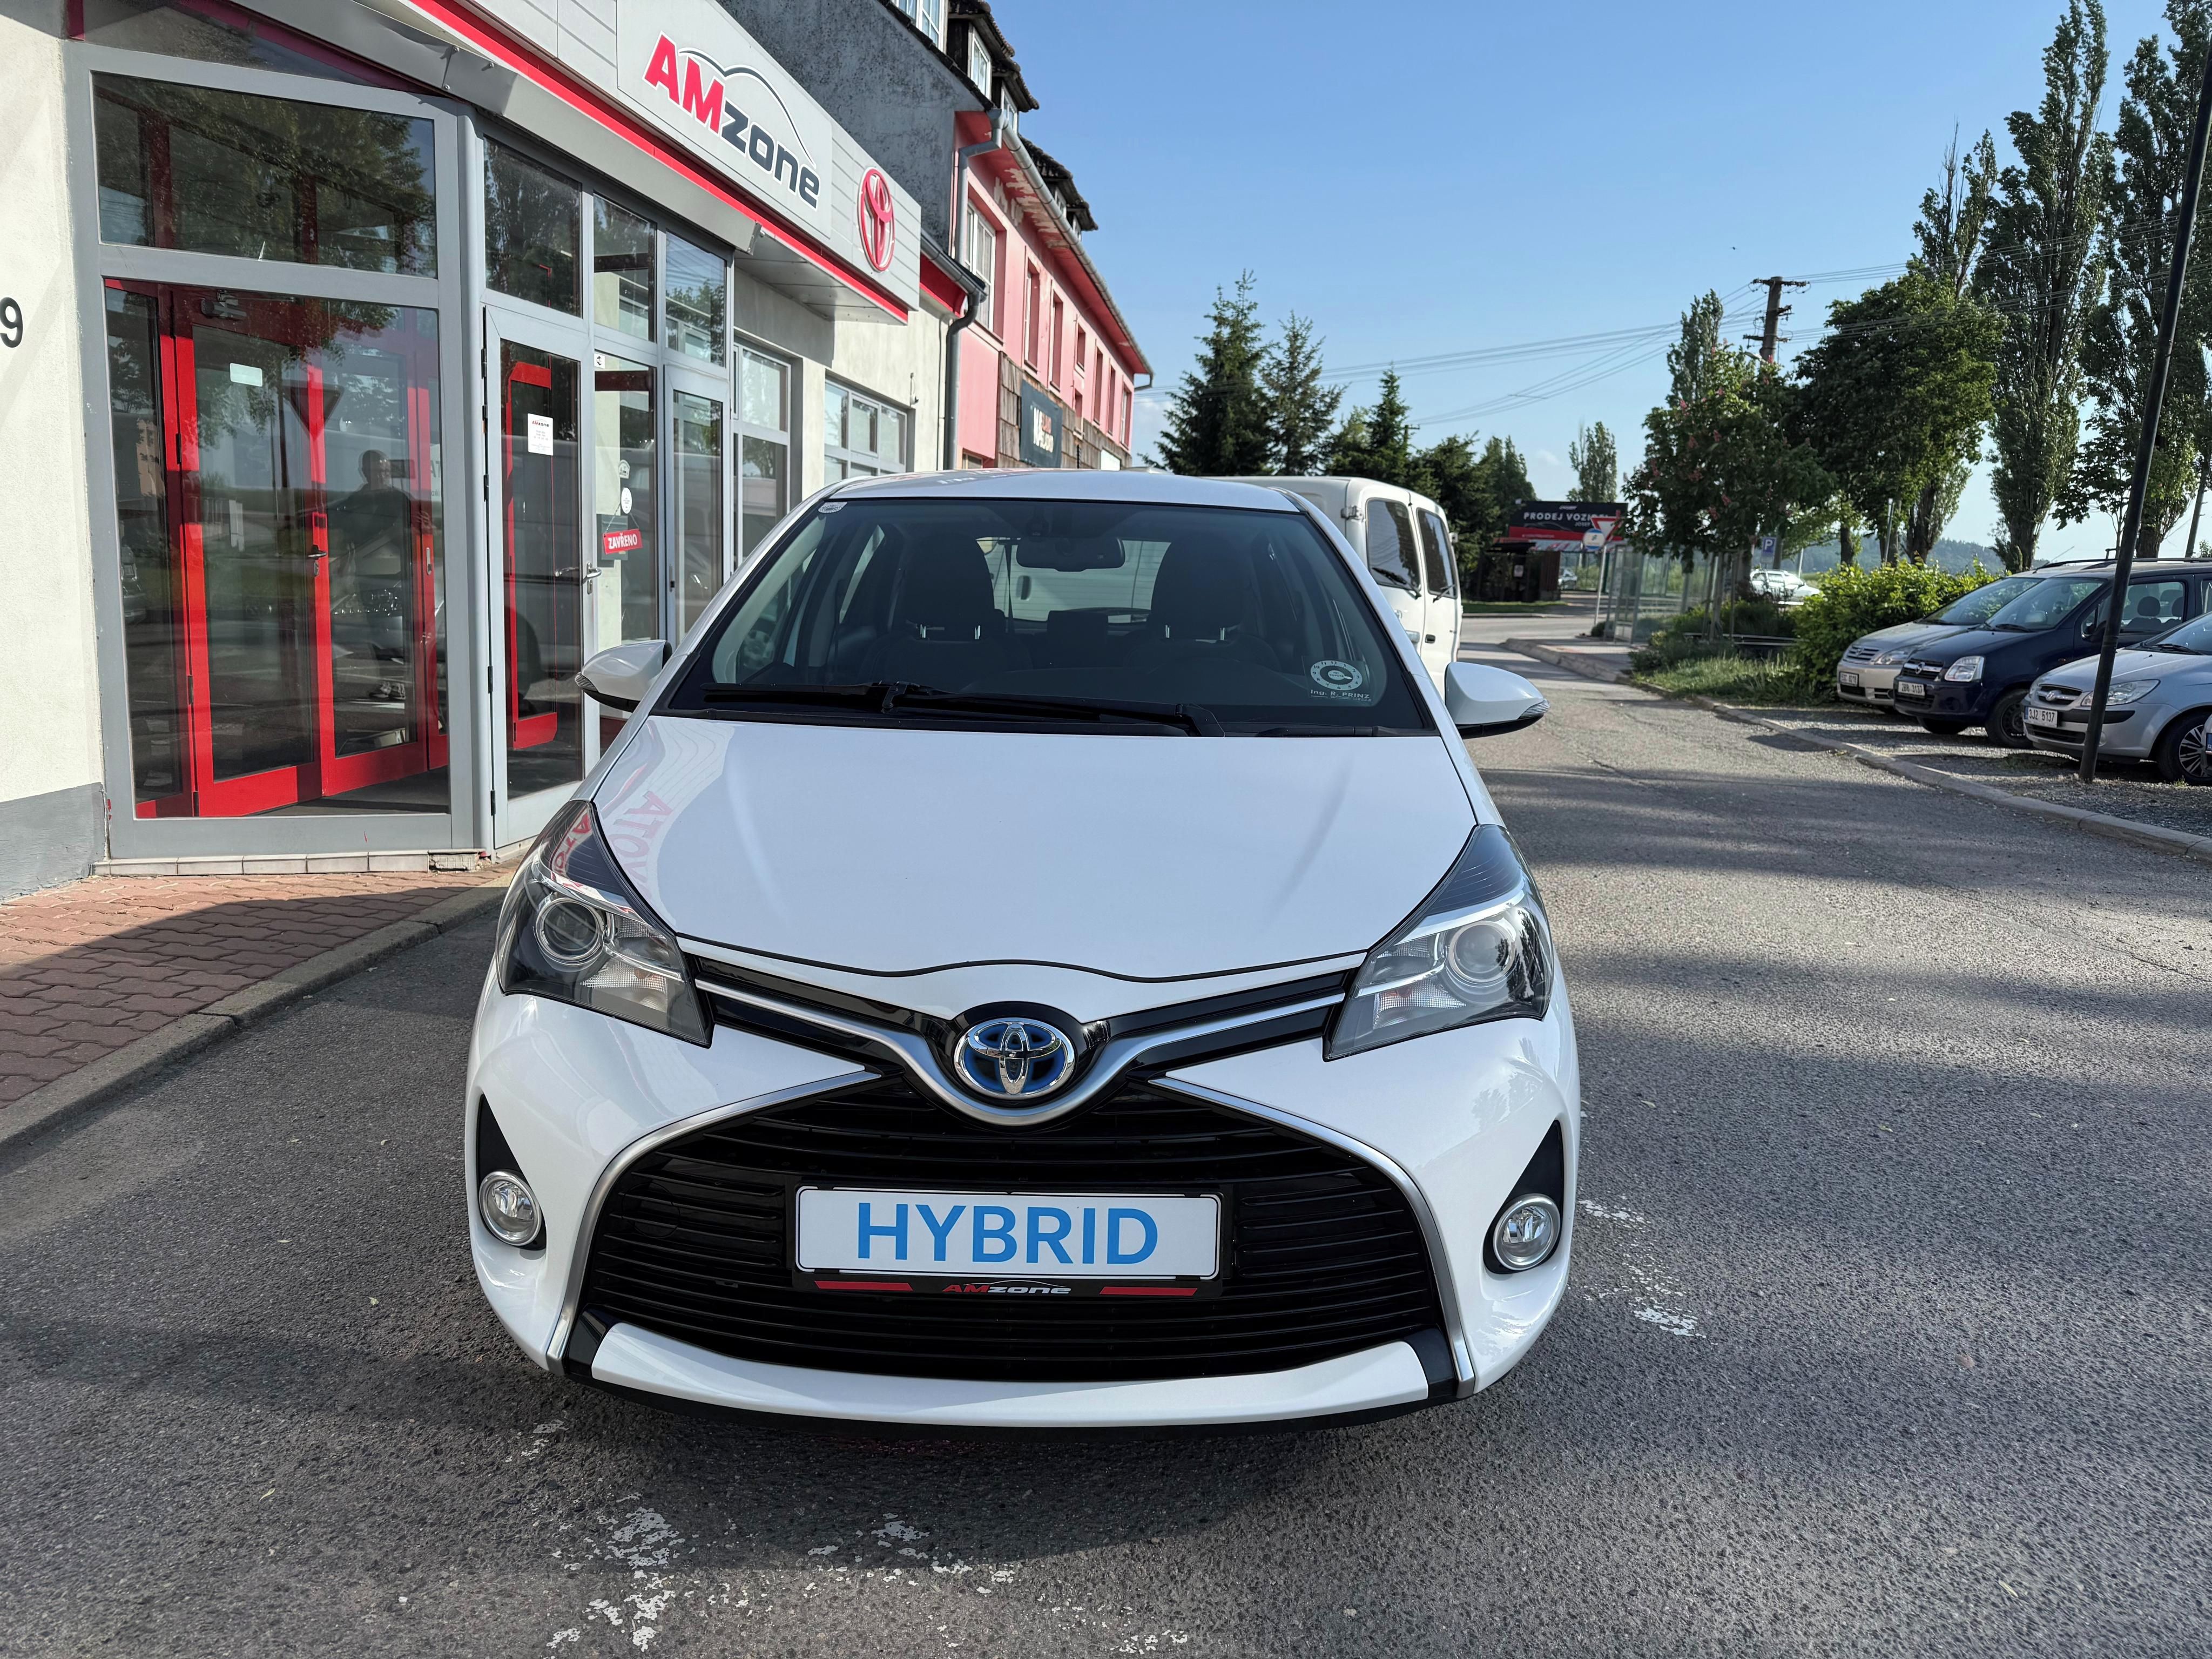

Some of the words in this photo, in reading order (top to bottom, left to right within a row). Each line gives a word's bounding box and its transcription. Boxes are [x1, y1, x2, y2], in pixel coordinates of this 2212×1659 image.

[643, 31, 820, 210] AMzone
[0, 297, 23, 348] 9
[1523, 512, 1563, 521] PRODEJ
[608, 532, 638, 550] ZAVŘENO
[1764, 539, 1773, 550] P
[2042, 711, 2055, 723] 5137
[857, 1202, 1158, 1265] HYBRID
[942, 1284, 1071, 1294] AMzone
